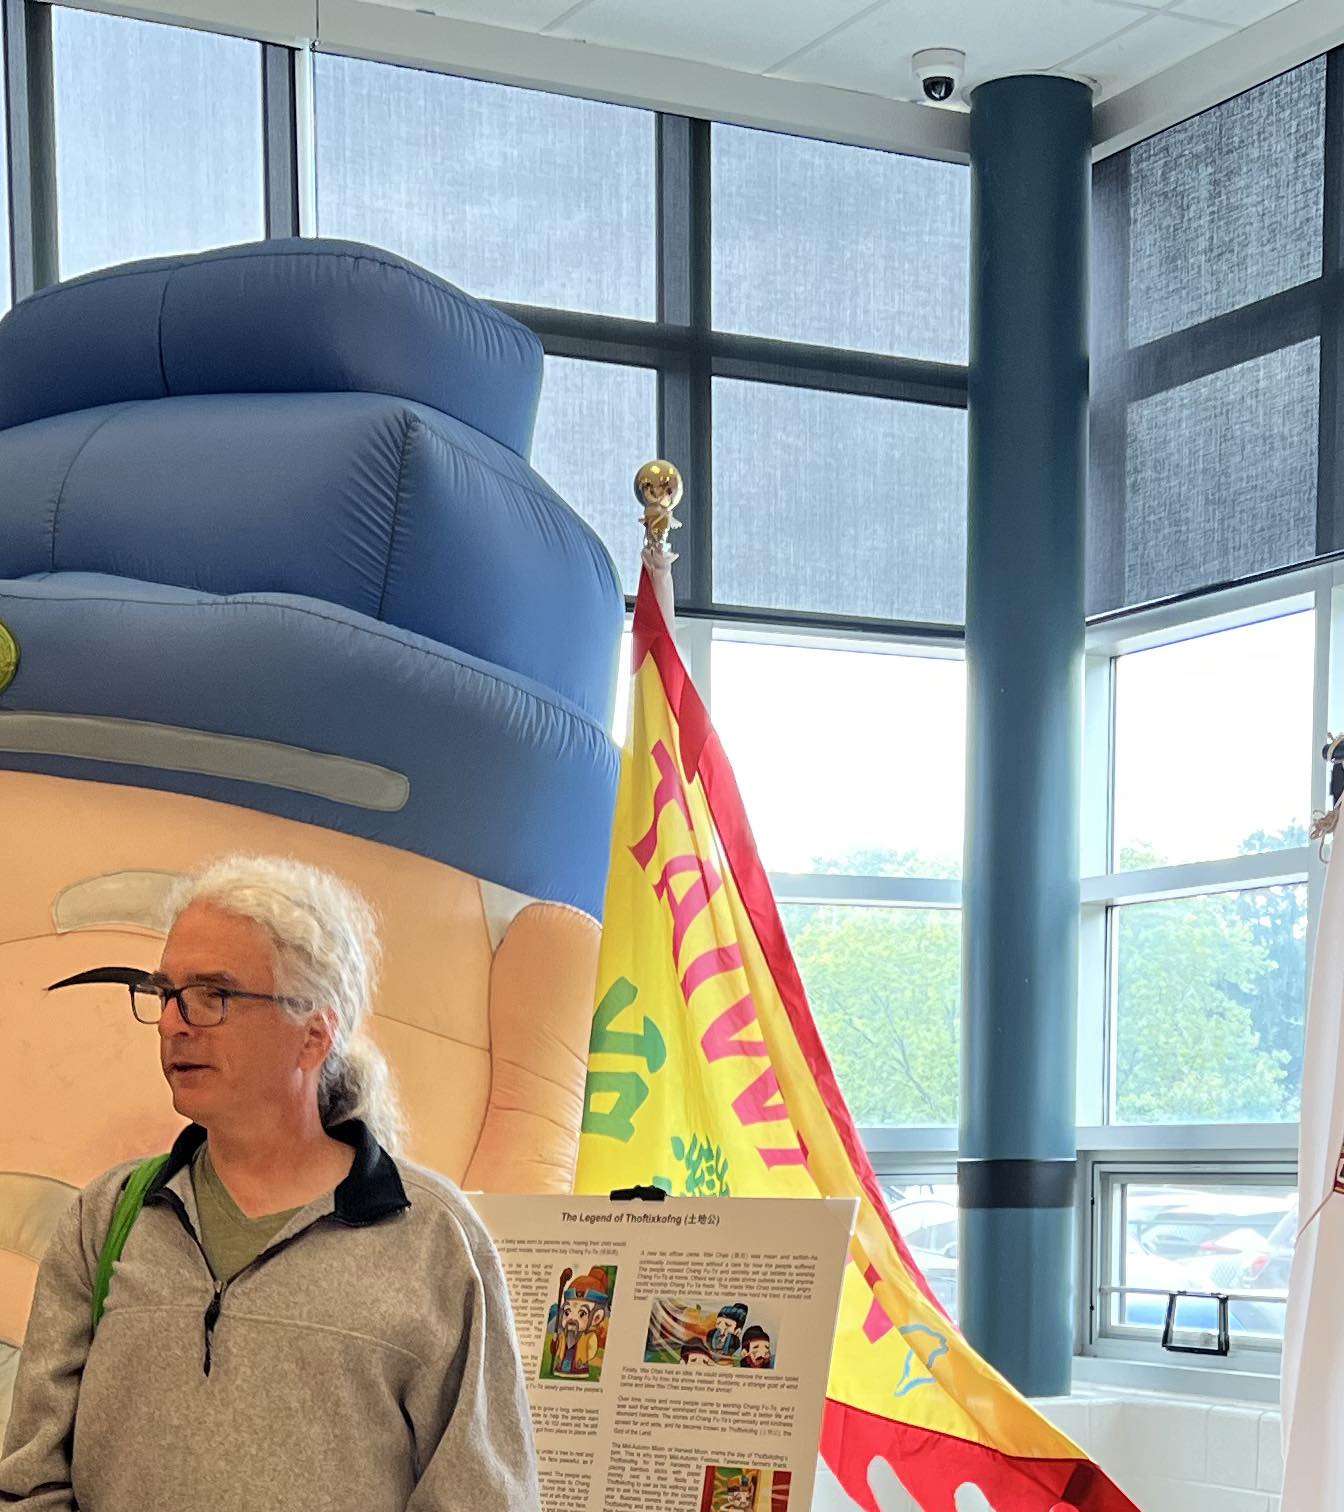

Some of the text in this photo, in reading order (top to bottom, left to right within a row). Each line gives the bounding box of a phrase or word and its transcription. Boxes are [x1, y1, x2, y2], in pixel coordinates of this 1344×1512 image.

[561, 1213, 577, 1222] The
[580, 1214, 611, 1224] Legend
[614, 1214, 625, 1223] of
